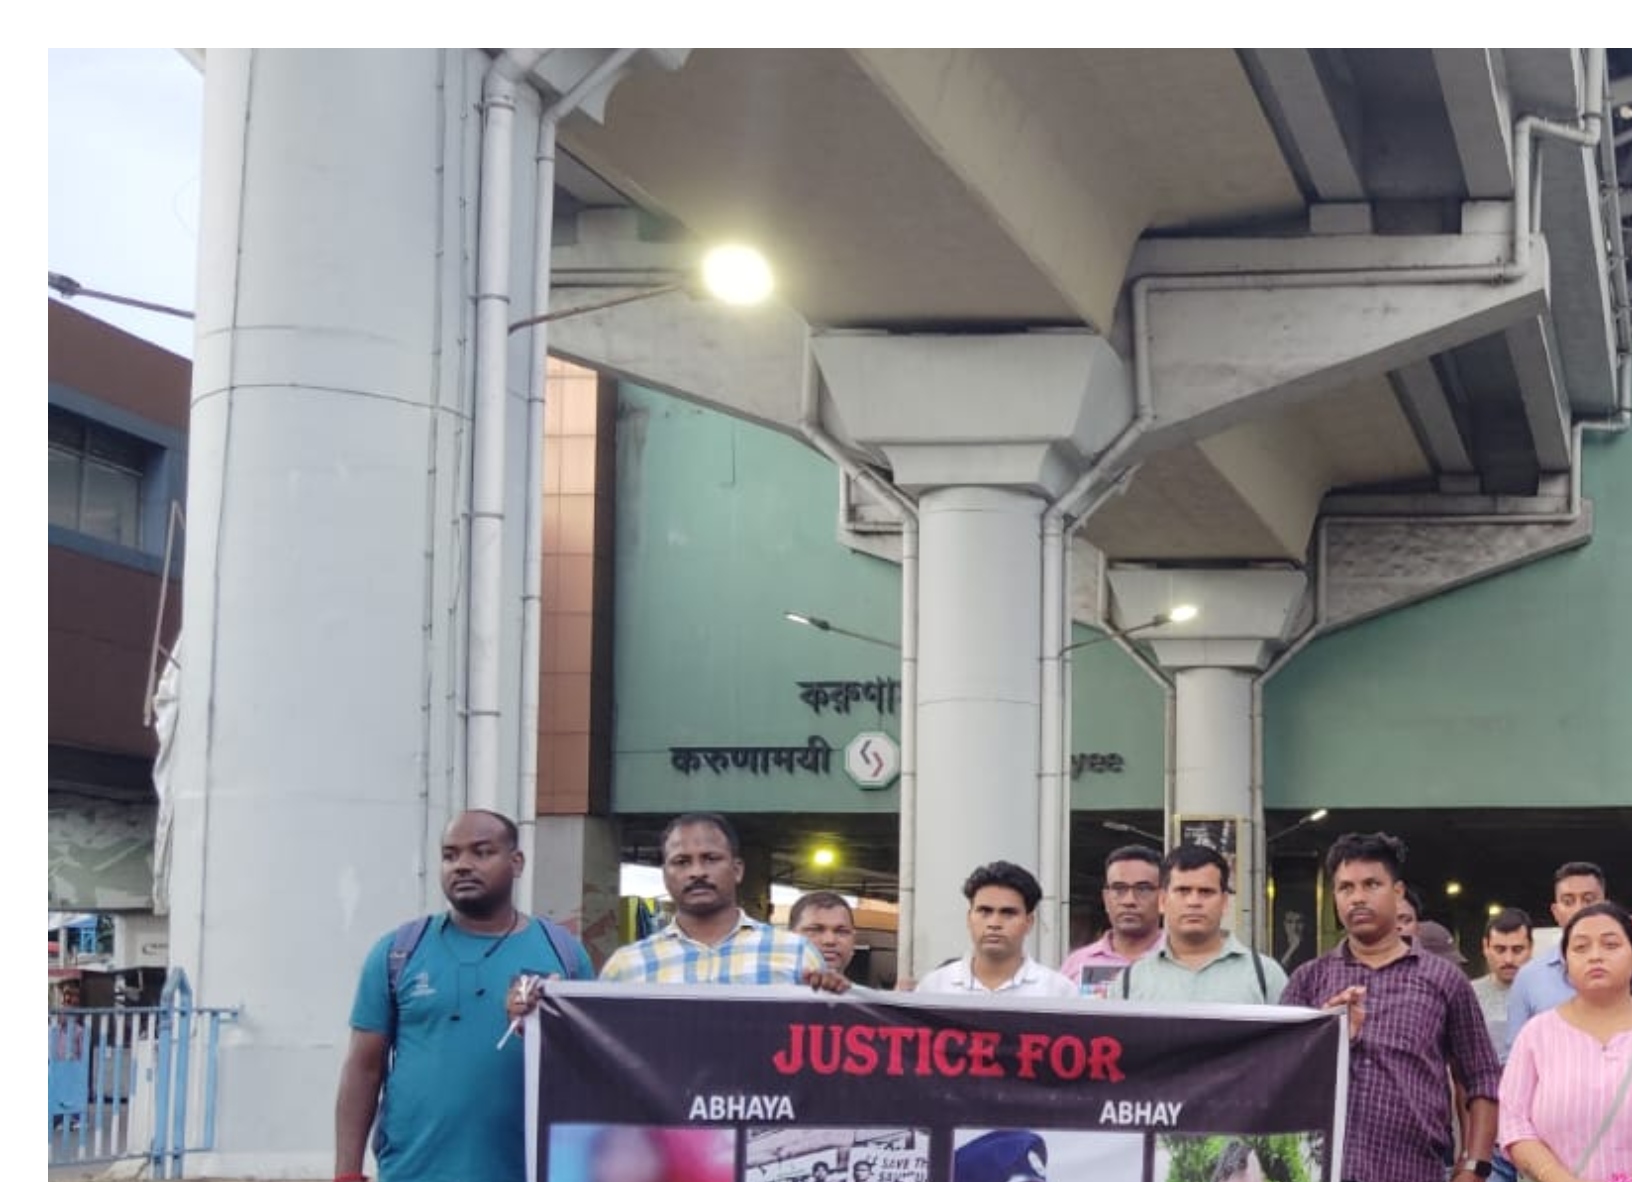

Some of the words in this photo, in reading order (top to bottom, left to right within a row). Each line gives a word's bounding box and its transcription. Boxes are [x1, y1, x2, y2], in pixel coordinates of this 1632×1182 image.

[796, 677, 901, 715] করুণা
[668, 735, 833, 776] करुणामयी
[773, 1024, 1004, 1076] JUSTICE
[1017, 1033, 1125, 1083] FOR
[689, 1095, 795, 1121] ABHAYA
[1099, 1100, 1184, 1127] ABHAY
